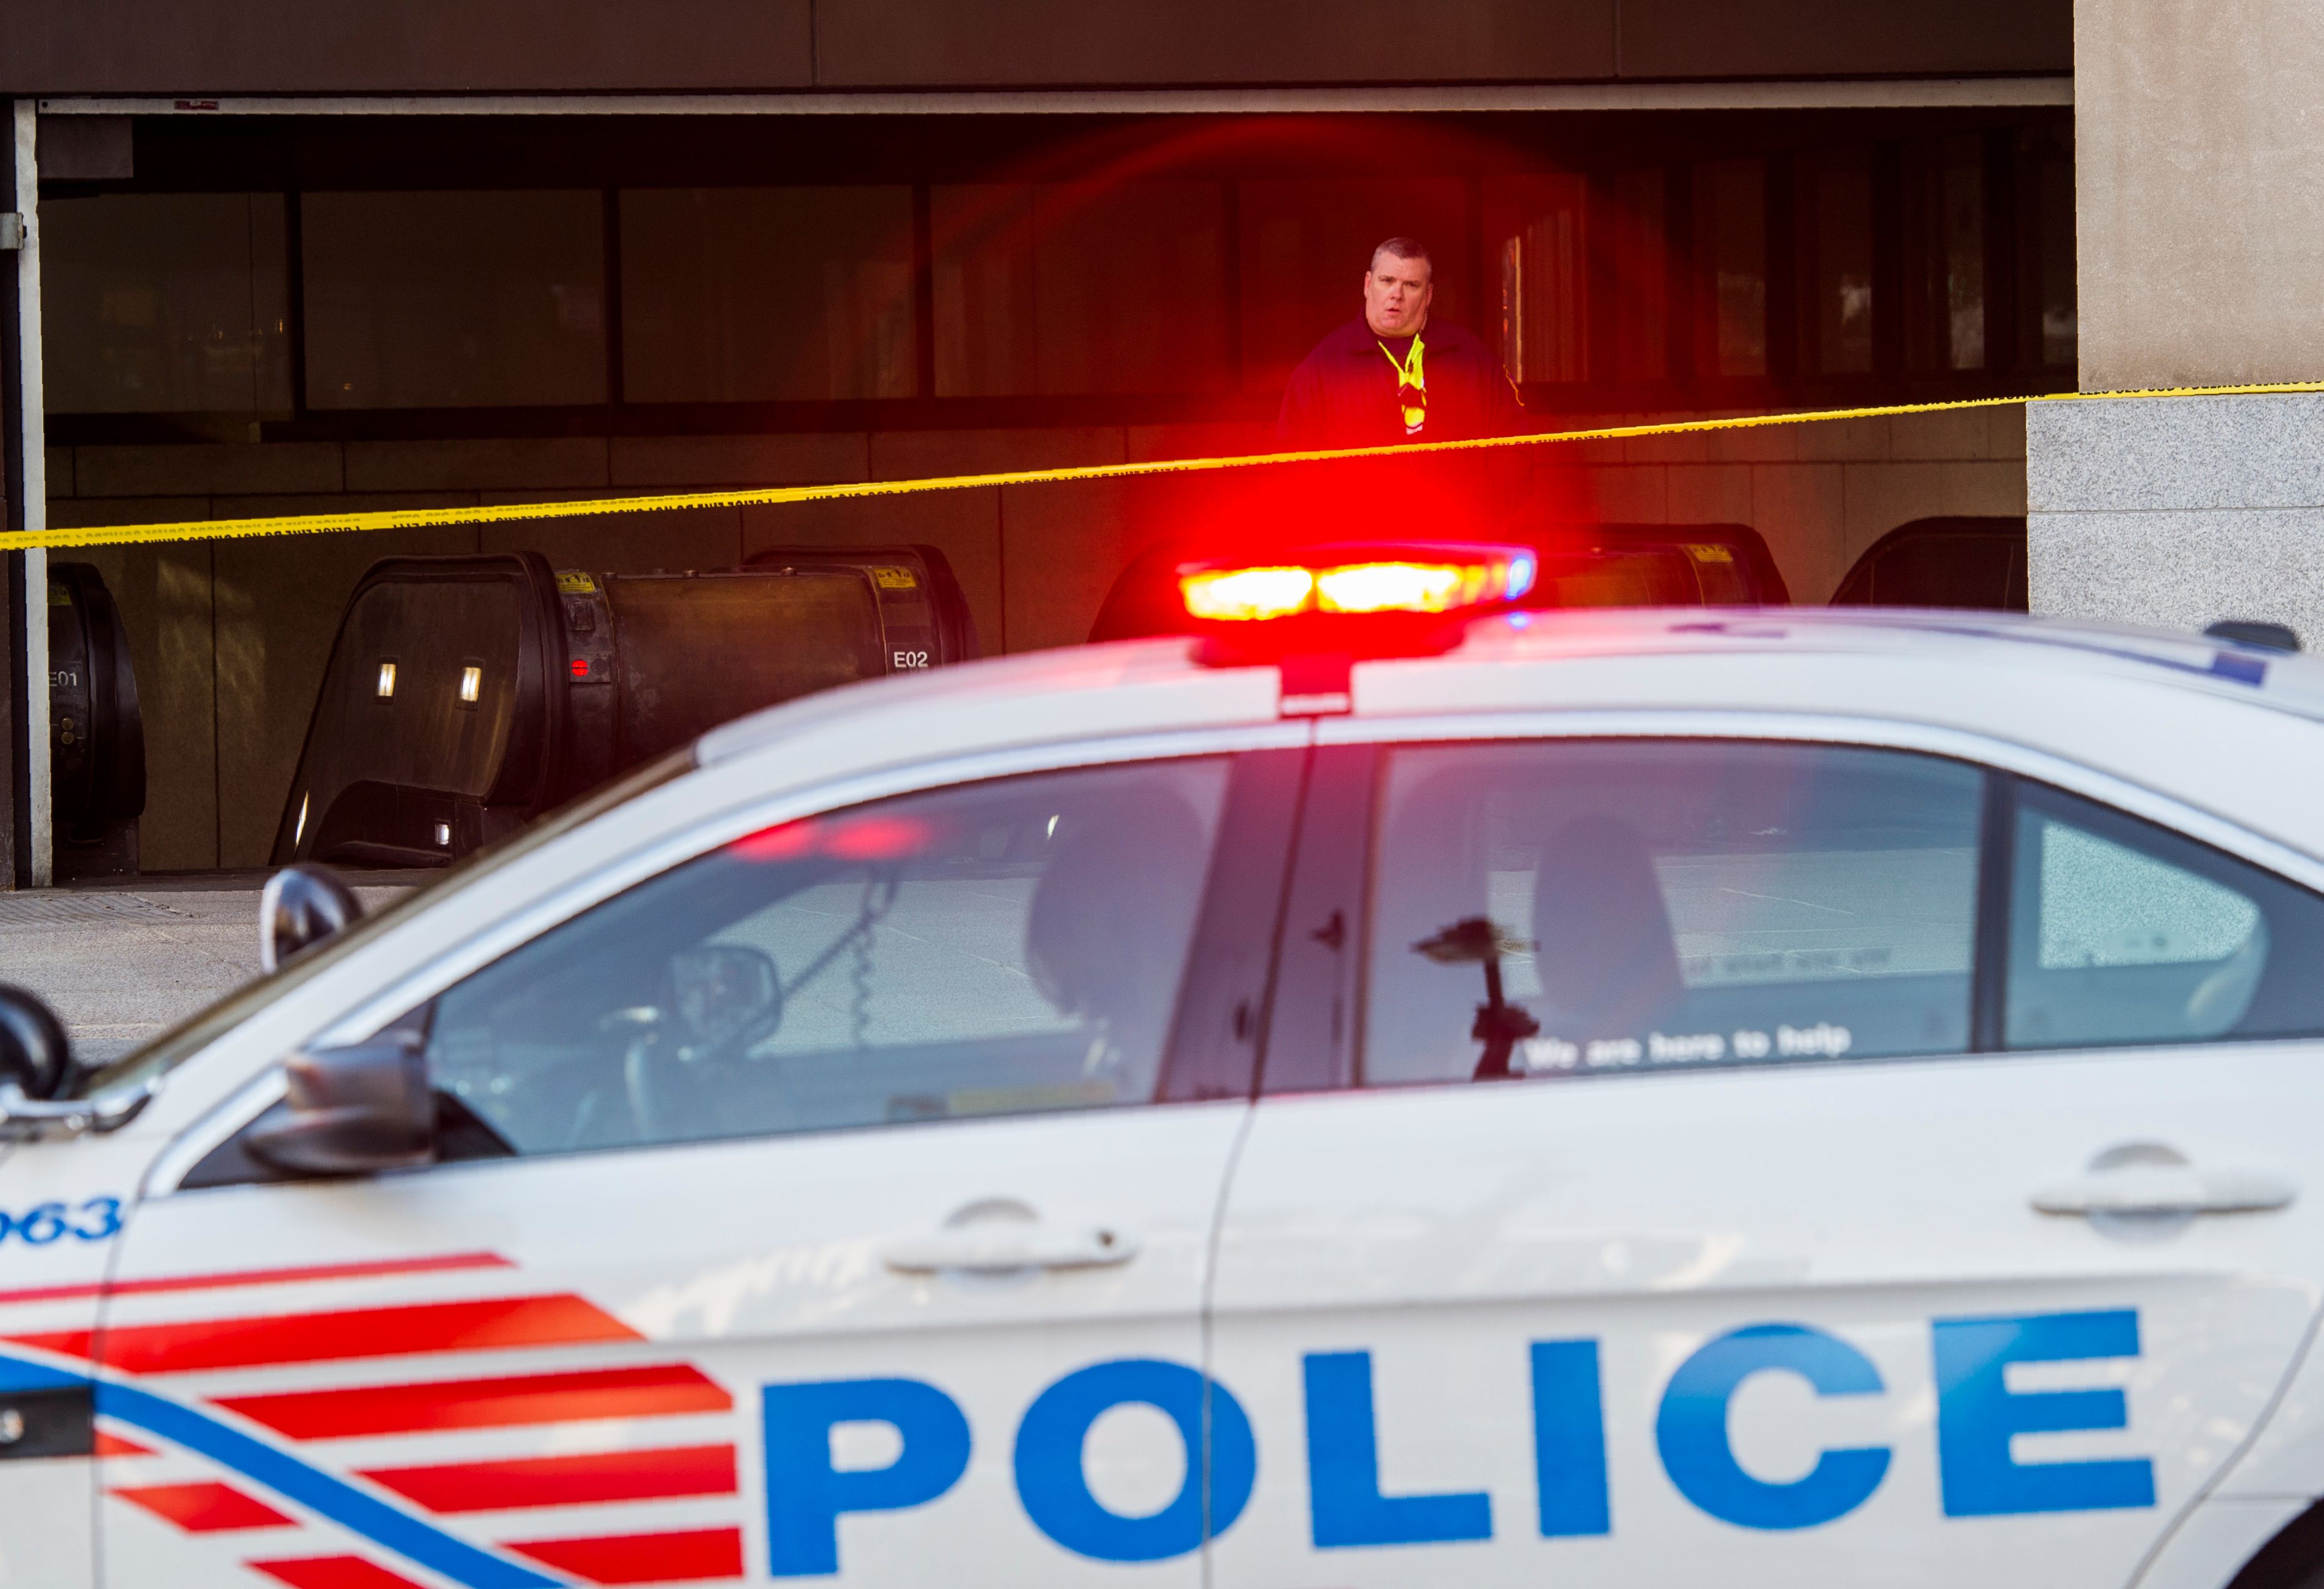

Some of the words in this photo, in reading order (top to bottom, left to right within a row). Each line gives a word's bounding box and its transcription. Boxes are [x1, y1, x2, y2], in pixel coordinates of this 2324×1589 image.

[893, 651, 928, 668] E02
[1525, 1036, 1579, 1069] We
[1586, 1037, 1642, 1067] are
[1649, 1031, 1726, 1062] here
[1733, 1029, 1771, 1057] to
[1777, 1022, 1851, 1057] help
[0, 1198, 121, 1245] 63
[762, 1309, 2156, 1578] POLICE
